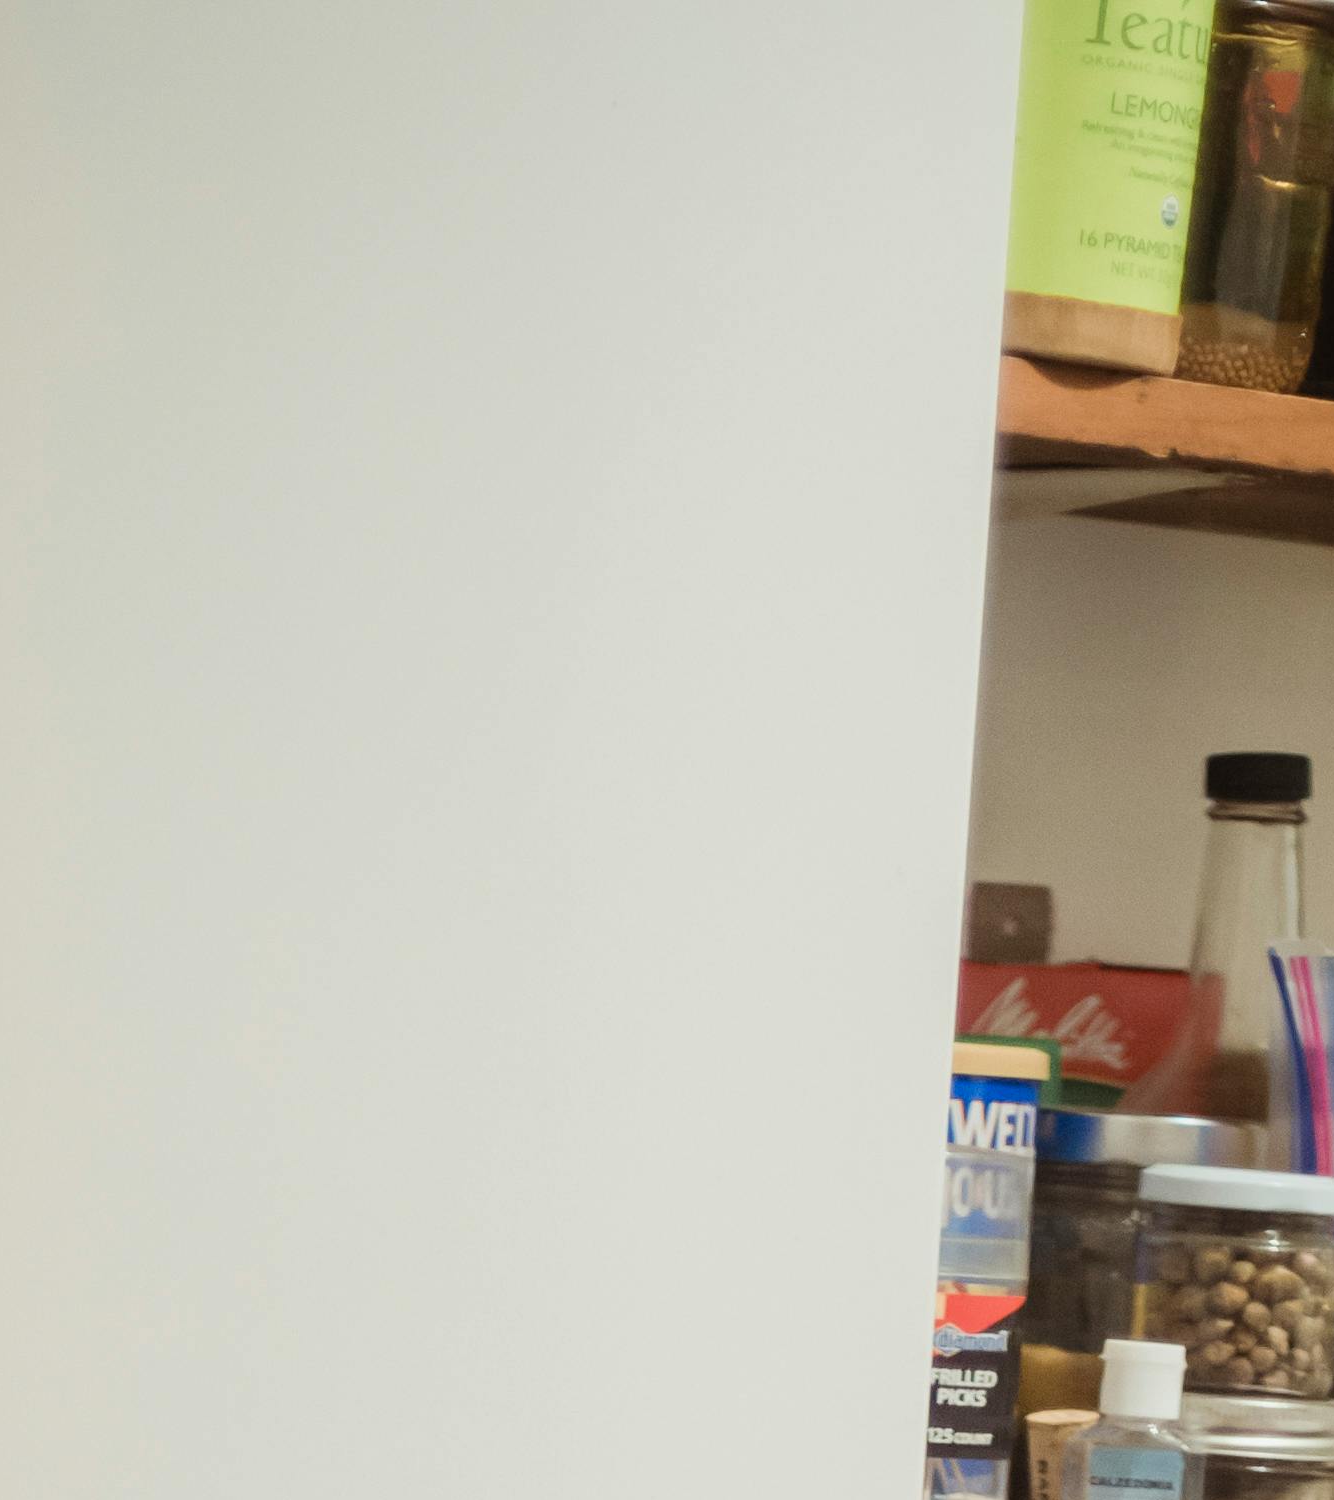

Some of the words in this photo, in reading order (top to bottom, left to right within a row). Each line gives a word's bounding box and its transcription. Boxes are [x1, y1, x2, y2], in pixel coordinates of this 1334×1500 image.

[1082, 54, 1152, 74] ORGANIC
[1079, 228, 1099, 247] 16
[1103, 231, 1169, 260] PYRAMID
[931, 1367, 998, 1389] FRILLED
[936, 1387, 988, 1407] PICKS
